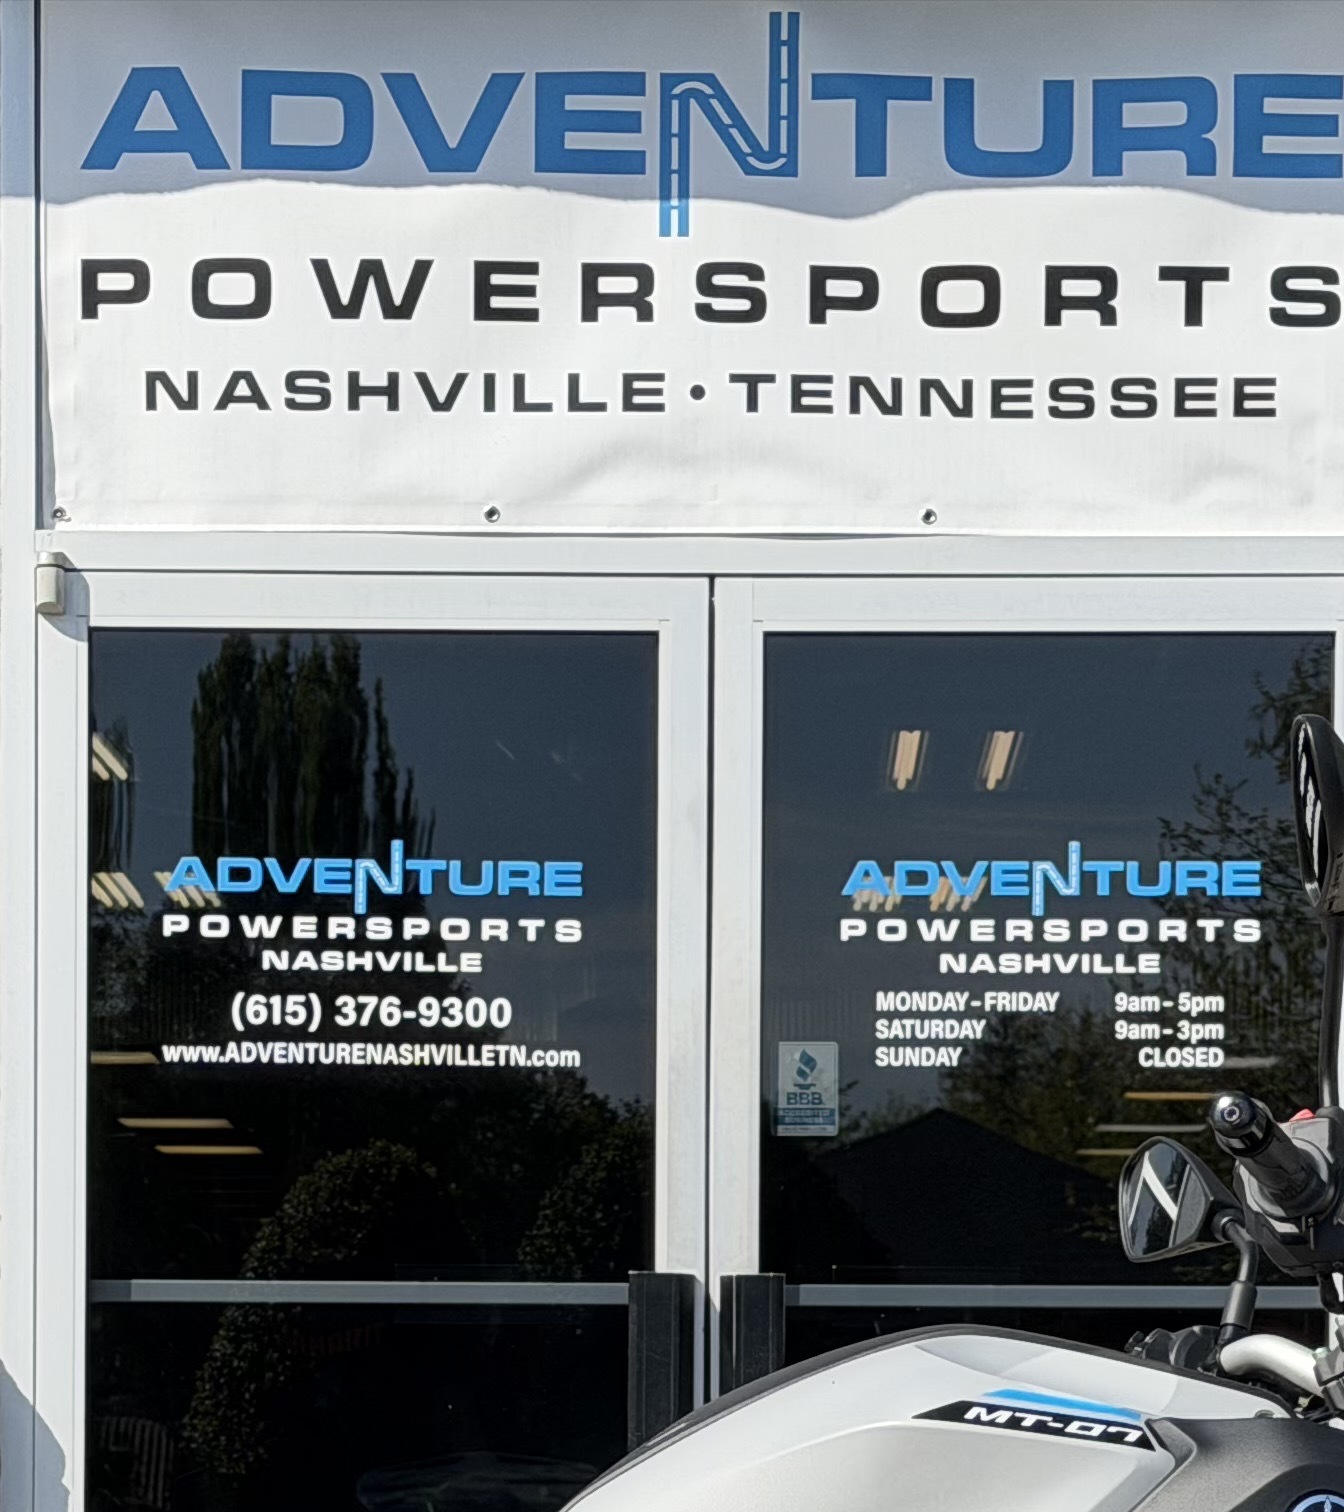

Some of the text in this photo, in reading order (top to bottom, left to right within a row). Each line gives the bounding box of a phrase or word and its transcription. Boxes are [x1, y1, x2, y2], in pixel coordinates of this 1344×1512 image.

[80, 258, 1343, 328] POWERSPORTS
[145, 370, 1277, 419] NASHVILLE TENNESSEE
[165, 839, 583, 914] ADVENTURE
[842, 840, 1262, 916] ADVENTURE
[162, 915, 582, 942] POWERSPORTS
[840, 918, 1261, 942] POWERSPORTS
[262, 950, 482, 973] NASHVILLE
[939, 953, 1161, 974] NASHVILLE
[231, 991, 512, 1032] (615) 376-9300
[875, 1018, 987, 1040] SATURDAY
[161, 1041, 581, 1068] www.ADVENTURENASHVILLETN.com
[875, 1046, 963, 1067] SUNDAY
[1138, 1046, 1225, 1067] CLOSED
[786, 1091, 823, 1106] BBB
[964, 1405, 1144, 1443] MT-07
